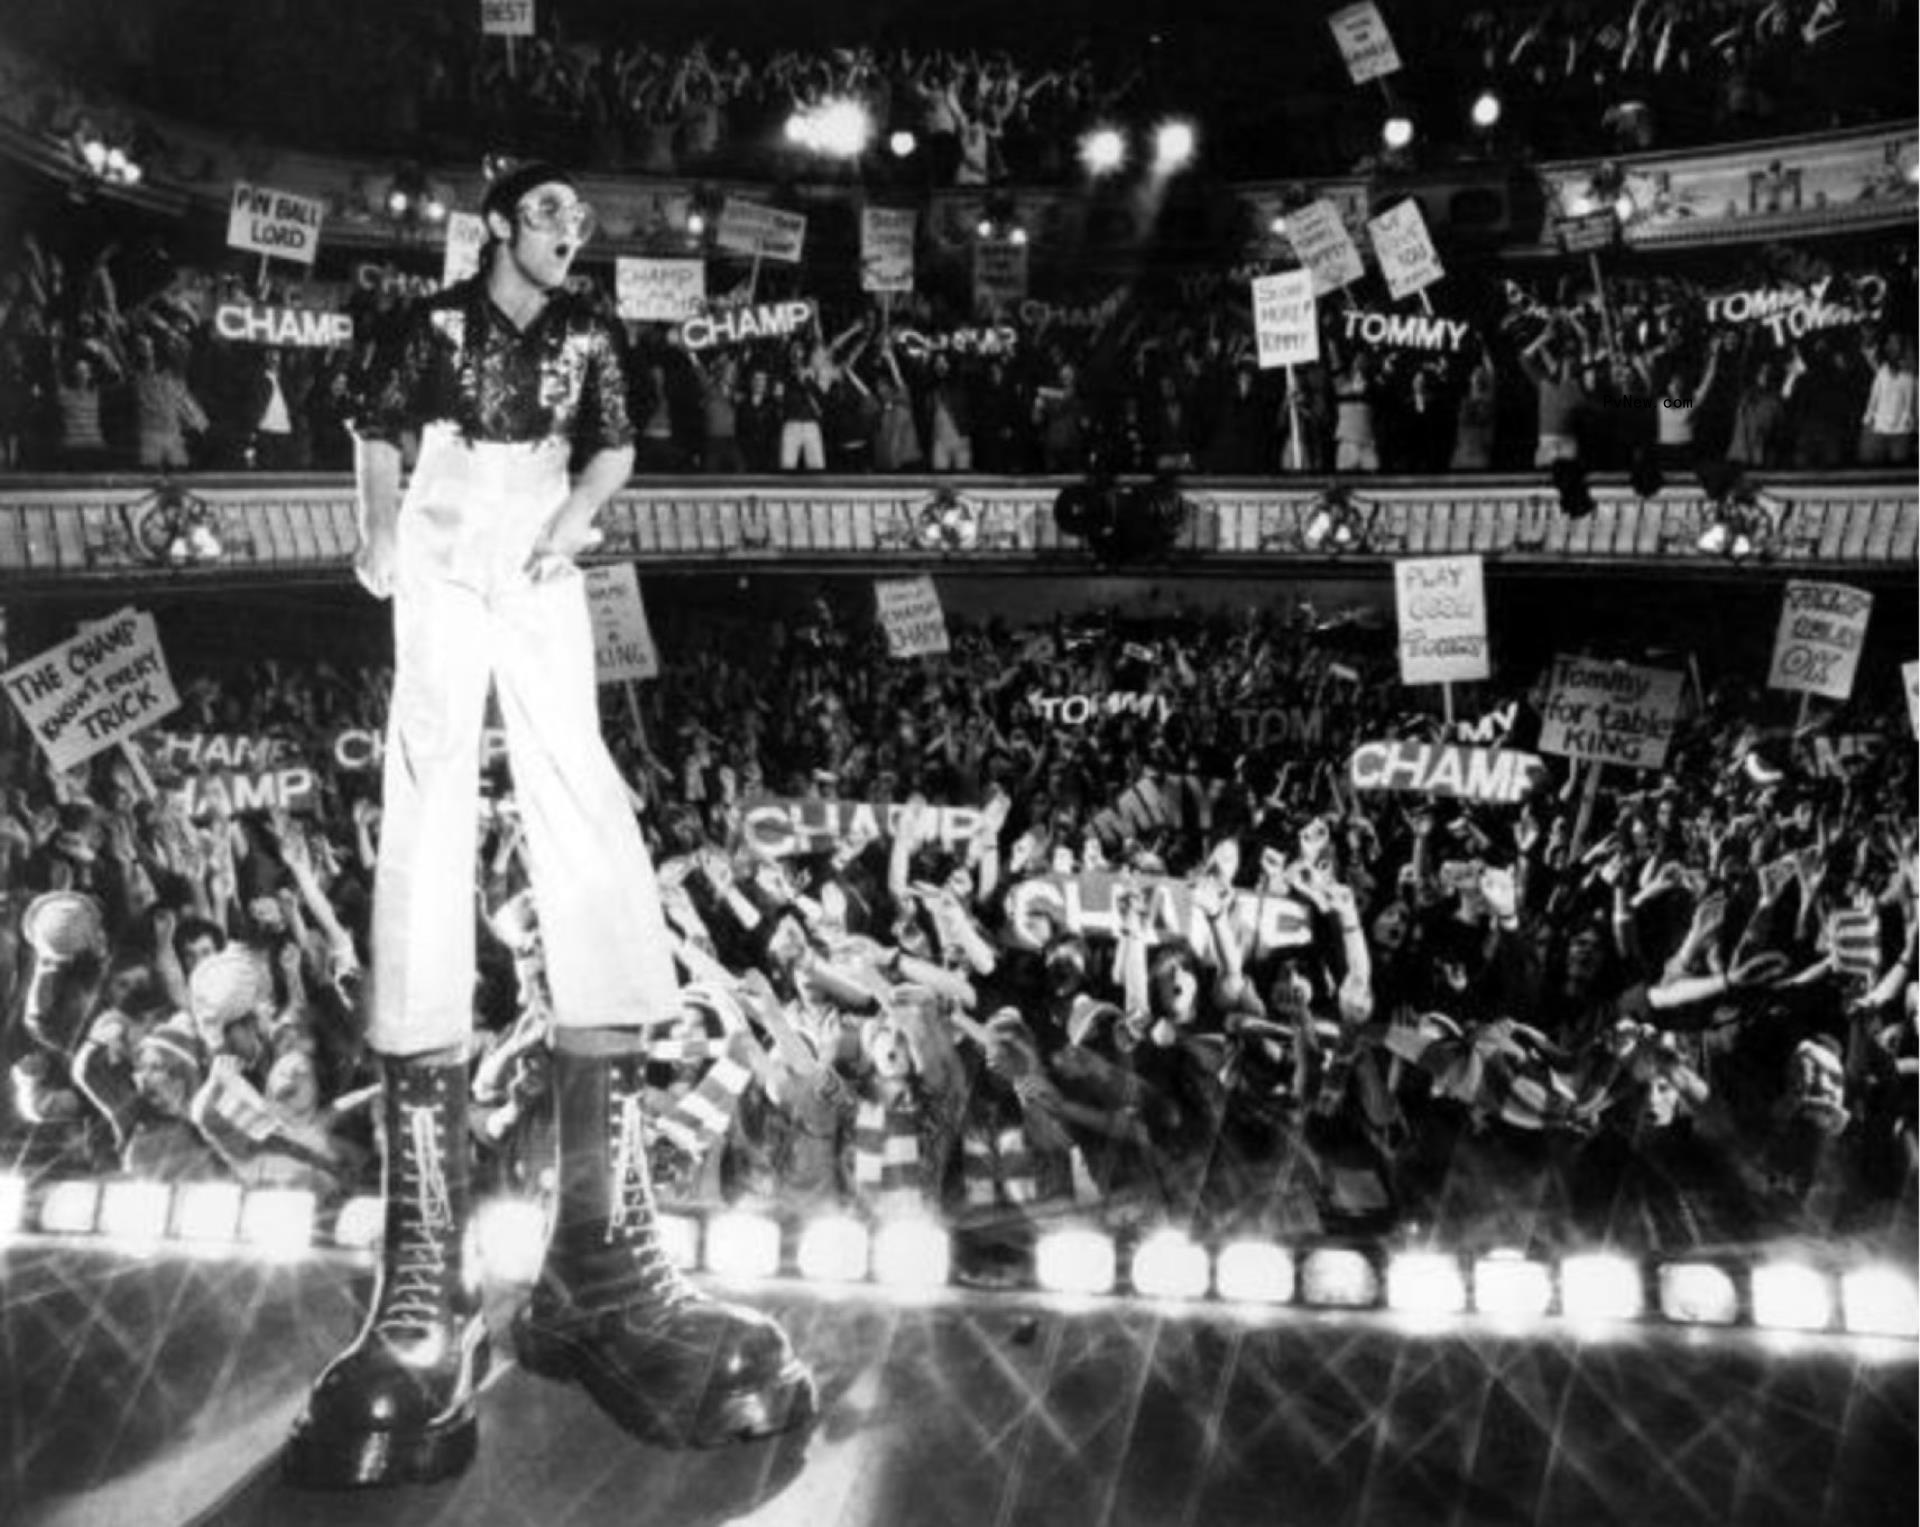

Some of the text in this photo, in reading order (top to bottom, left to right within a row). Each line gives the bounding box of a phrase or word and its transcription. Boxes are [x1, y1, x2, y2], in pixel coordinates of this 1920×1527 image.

[251, 222, 305, 249] LORD
[216, 304, 354, 347] CHAMP
[682, 301, 811, 348] CHAMP
[1342, 309, 1469, 351] TOMMY
[6, 618, 138, 706] THE CHAMP
[78, 681, 160, 741] TRICK
[1549, 692, 1586, 725] for
[1562, 725, 1642, 762] KING
